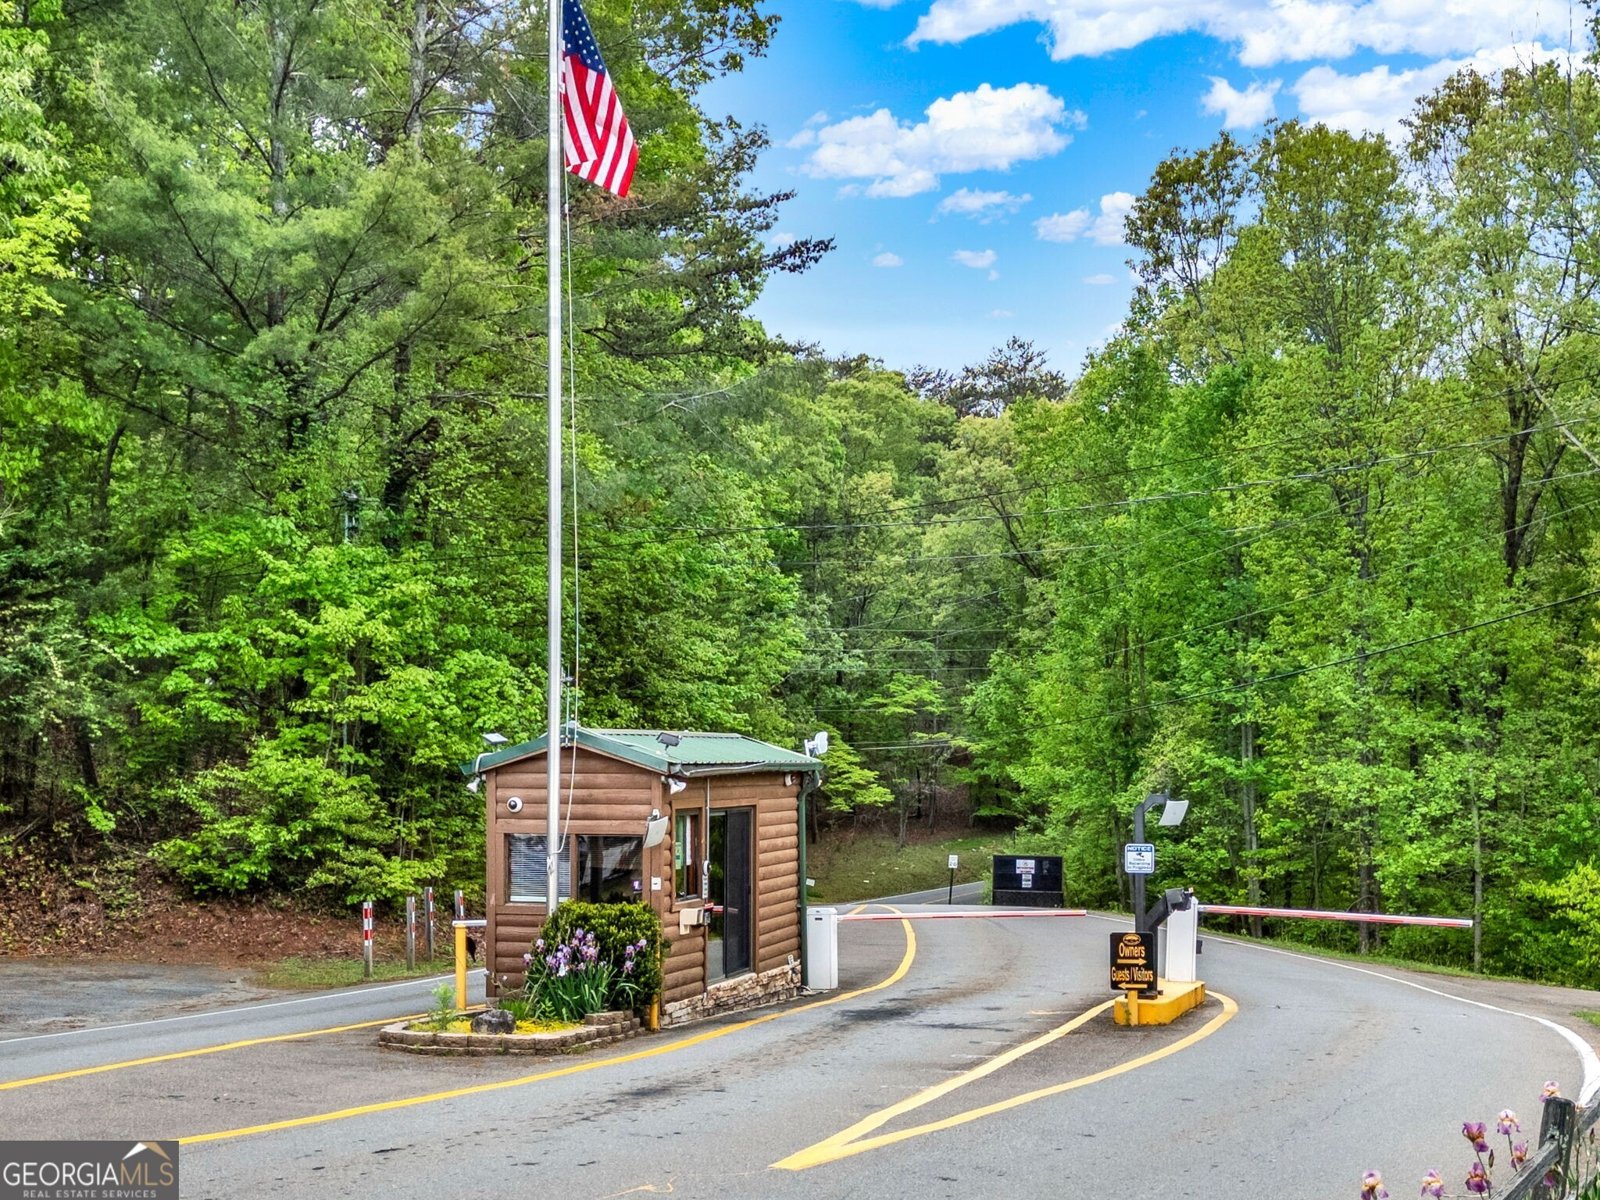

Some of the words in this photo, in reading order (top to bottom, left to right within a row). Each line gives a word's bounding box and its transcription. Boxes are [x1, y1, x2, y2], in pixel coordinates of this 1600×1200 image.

[1119, 942, 1145, 957] Owners
[1111, 966, 1130, 981] Guests
[1132, 966, 1153, 981] Visitors
